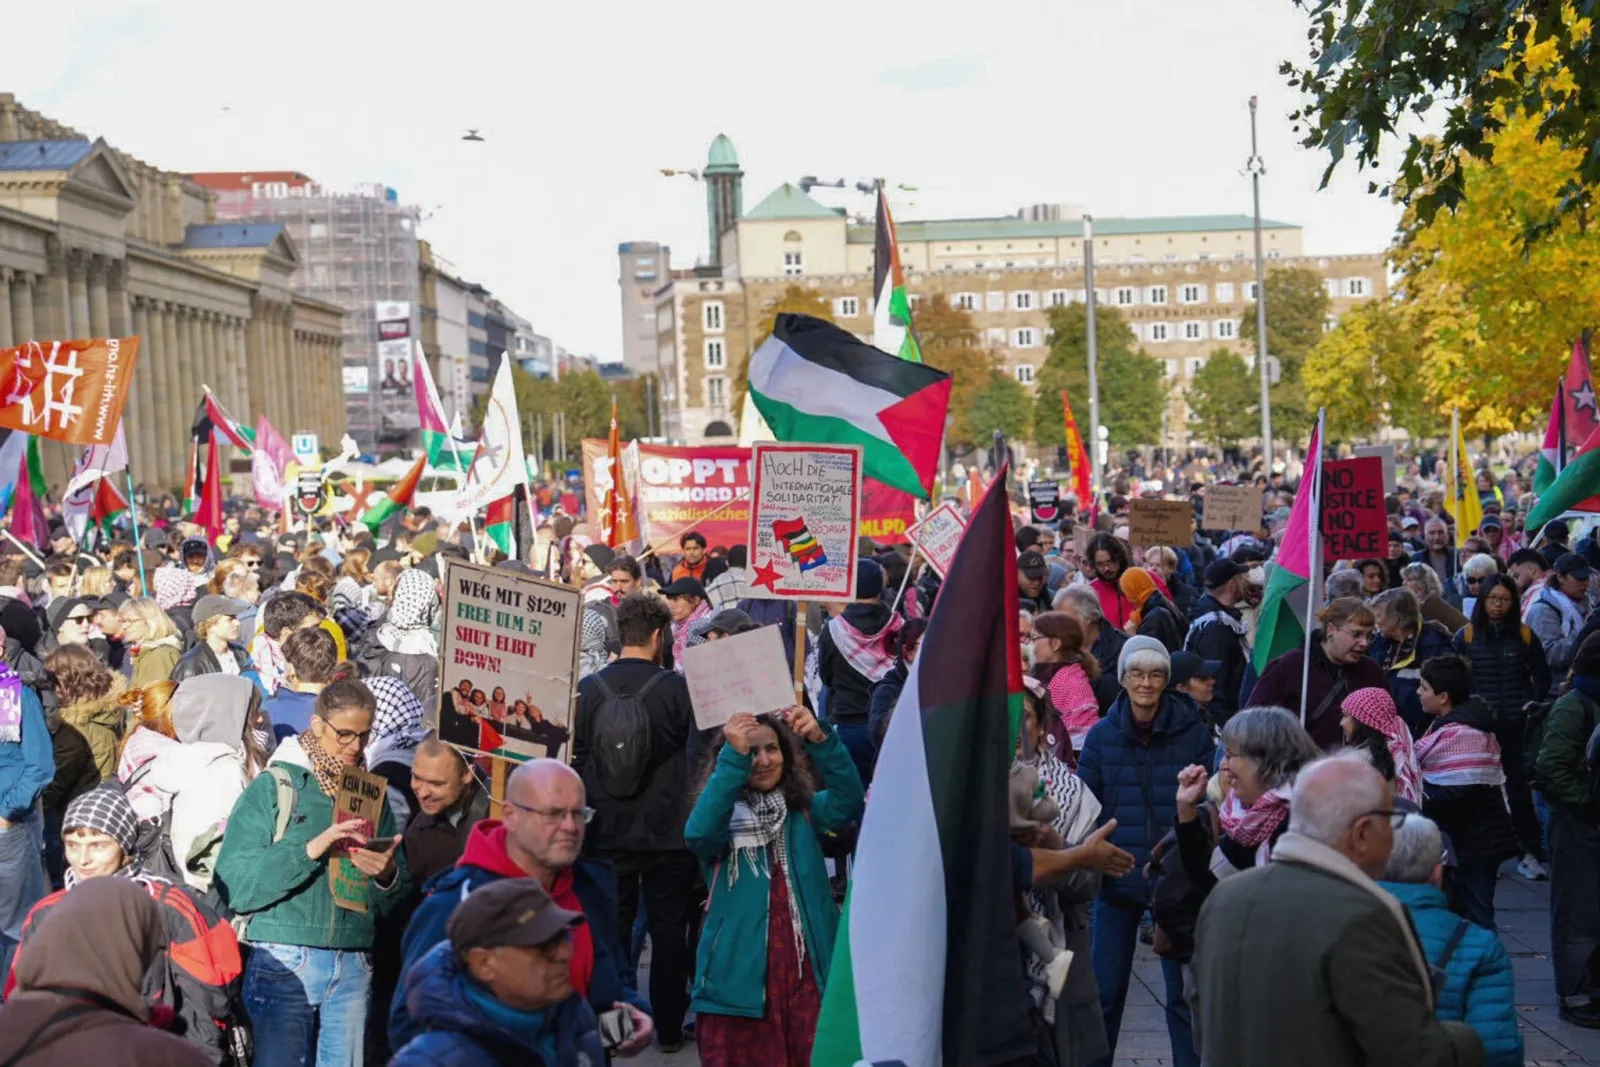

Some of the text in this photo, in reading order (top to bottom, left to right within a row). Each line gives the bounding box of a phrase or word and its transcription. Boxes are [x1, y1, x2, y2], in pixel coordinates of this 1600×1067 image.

[592, 456, 740, 485] SOPPT
[763, 454, 804, 477] HOCH
[807, 465, 827, 477] DIE
[1324, 468, 1354, 489] NO
[1322, 489, 1377, 510] USTICE
[1328, 510, 1355, 531] NO
[459, 579, 567, 618] WEG MIT §129!
[457, 601, 543, 636] FREE ULM 5!
[456, 625, 537, 659] SHUT ELBIT
[454, 648, 502, 674] DOWN!
[350, 797, 363, 813] IST
